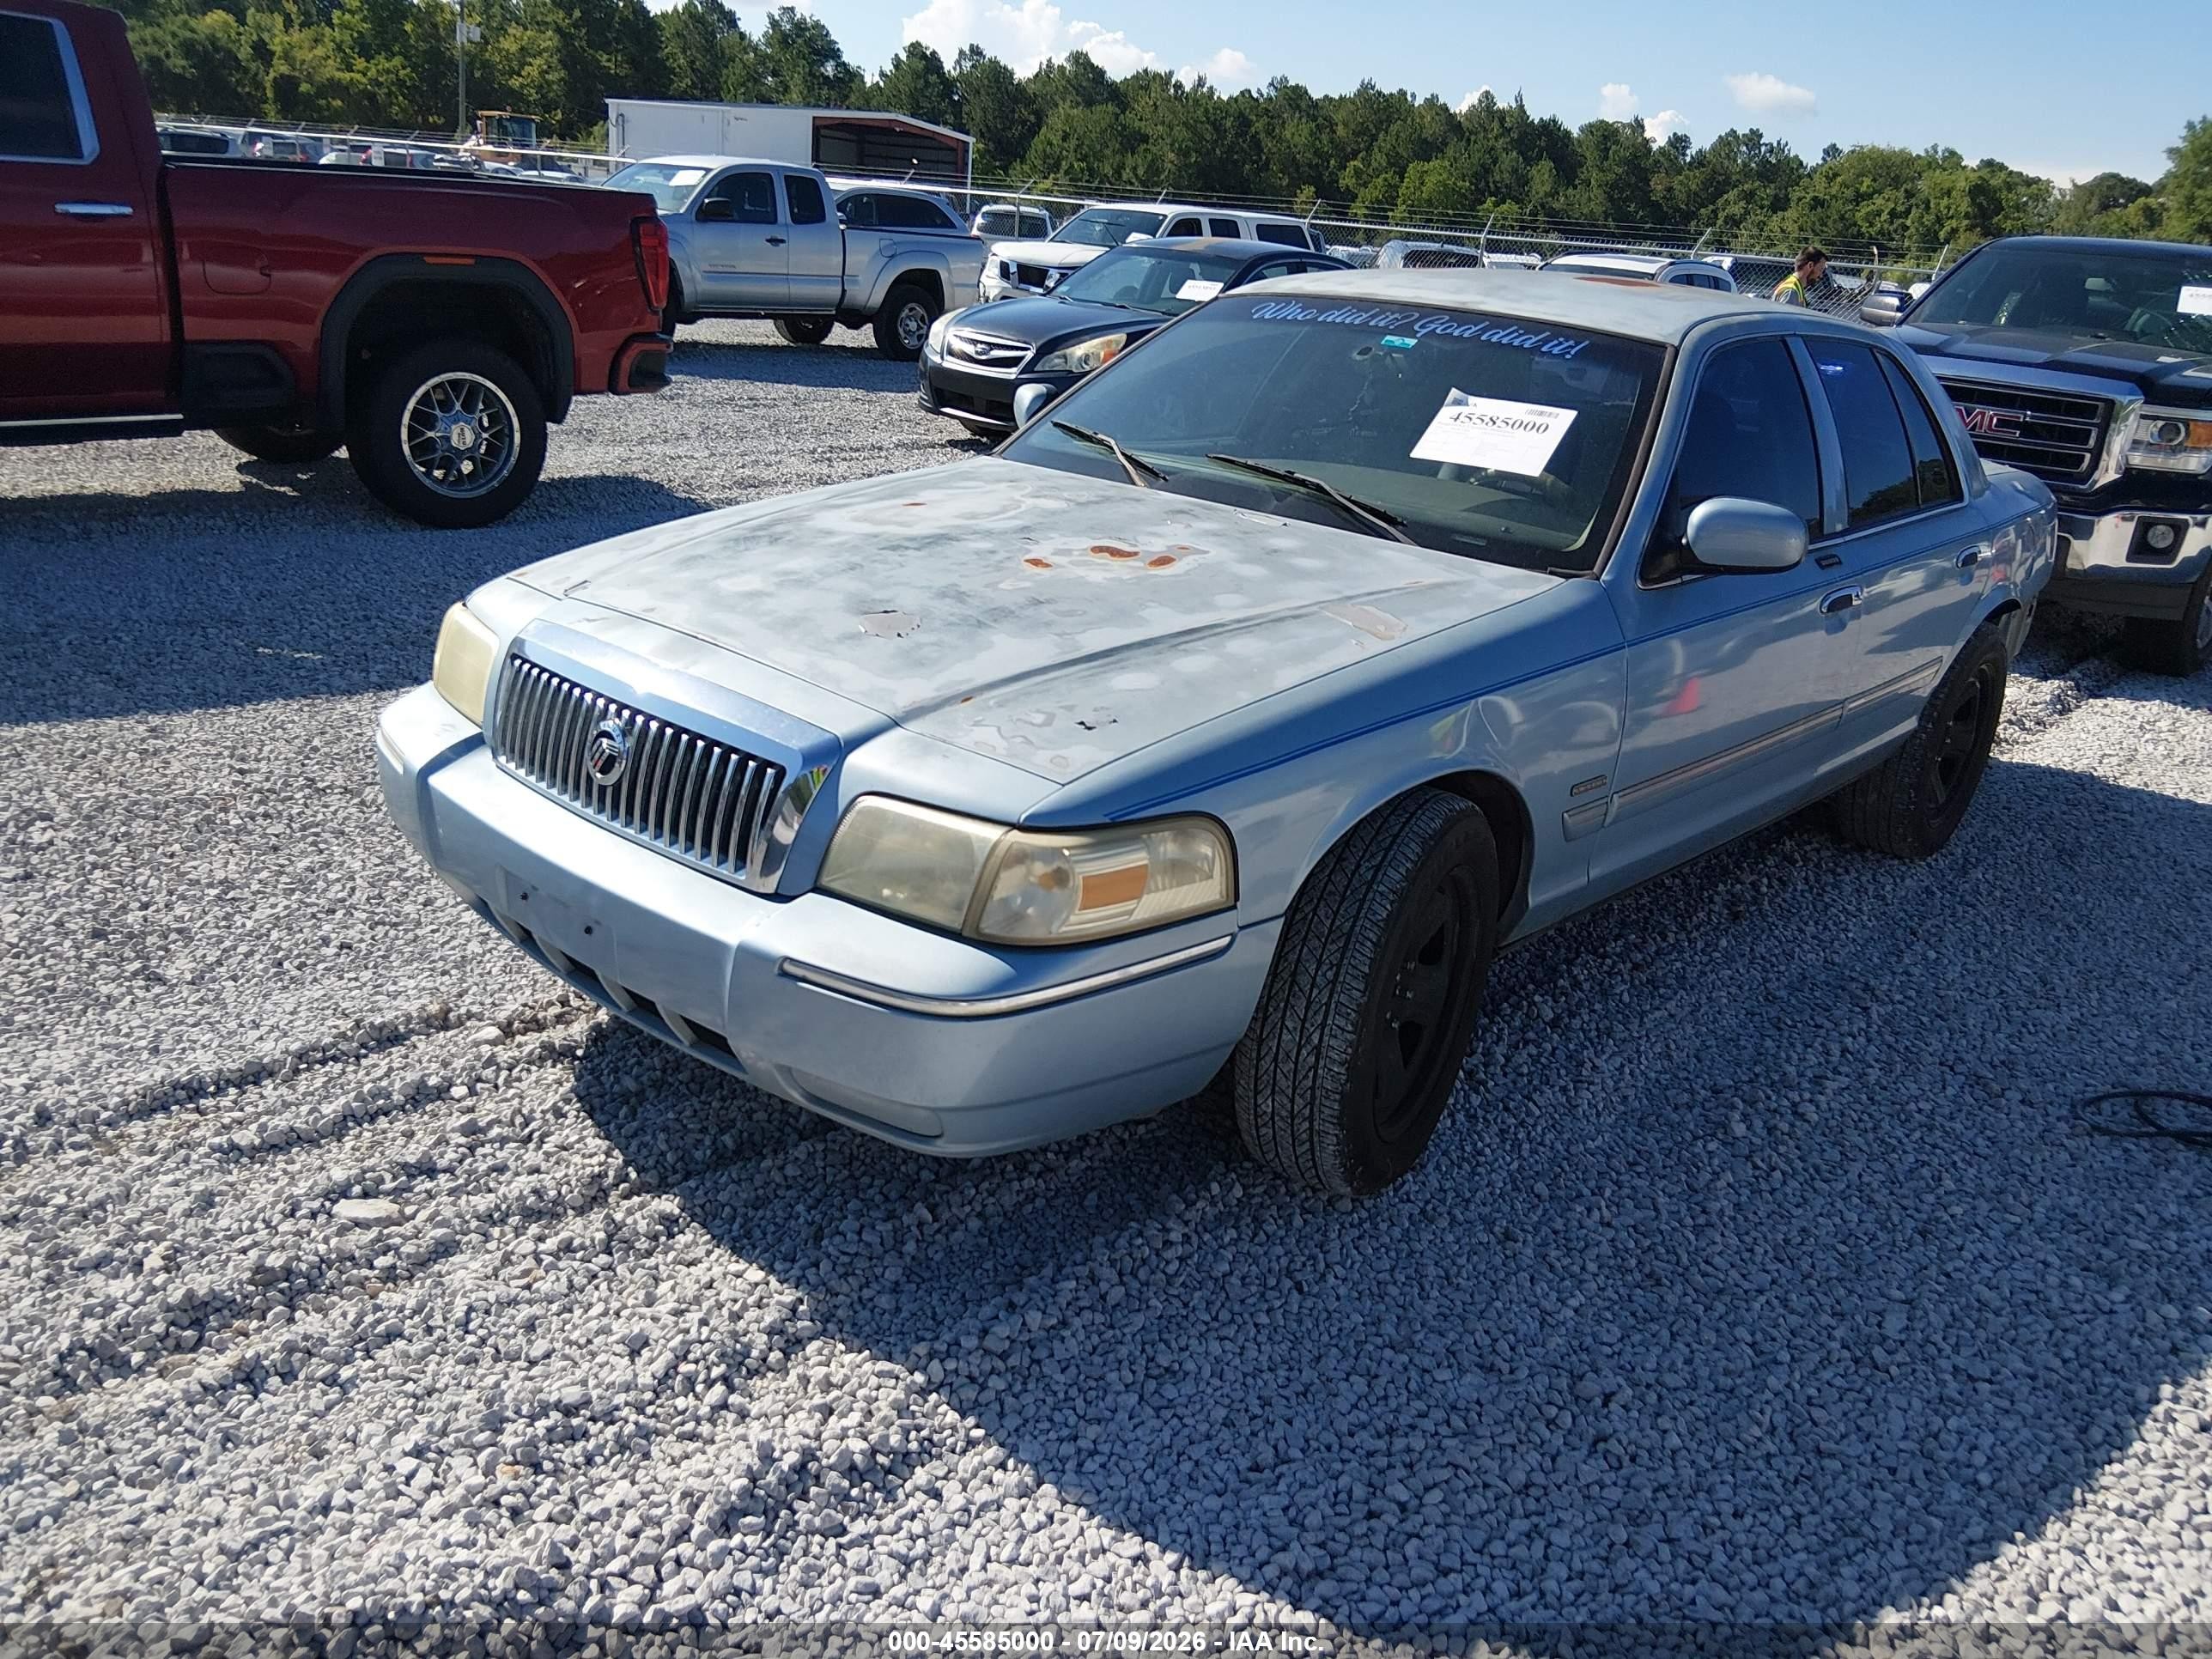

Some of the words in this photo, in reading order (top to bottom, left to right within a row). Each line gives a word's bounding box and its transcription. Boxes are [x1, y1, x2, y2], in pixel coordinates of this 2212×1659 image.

[1251, 300, 1319, 320] Who
[1317, 306, 1371, 325] did
[1369, 311, 1420, 330] it?
[1413, 314, 1490, 337] God
[1480, 325, 1551, 349] did
[1540, 337, 1589, 359] it!
[1449, 411, 1550, 434] 45585000
[1954, 405, 2024, 437] MC
